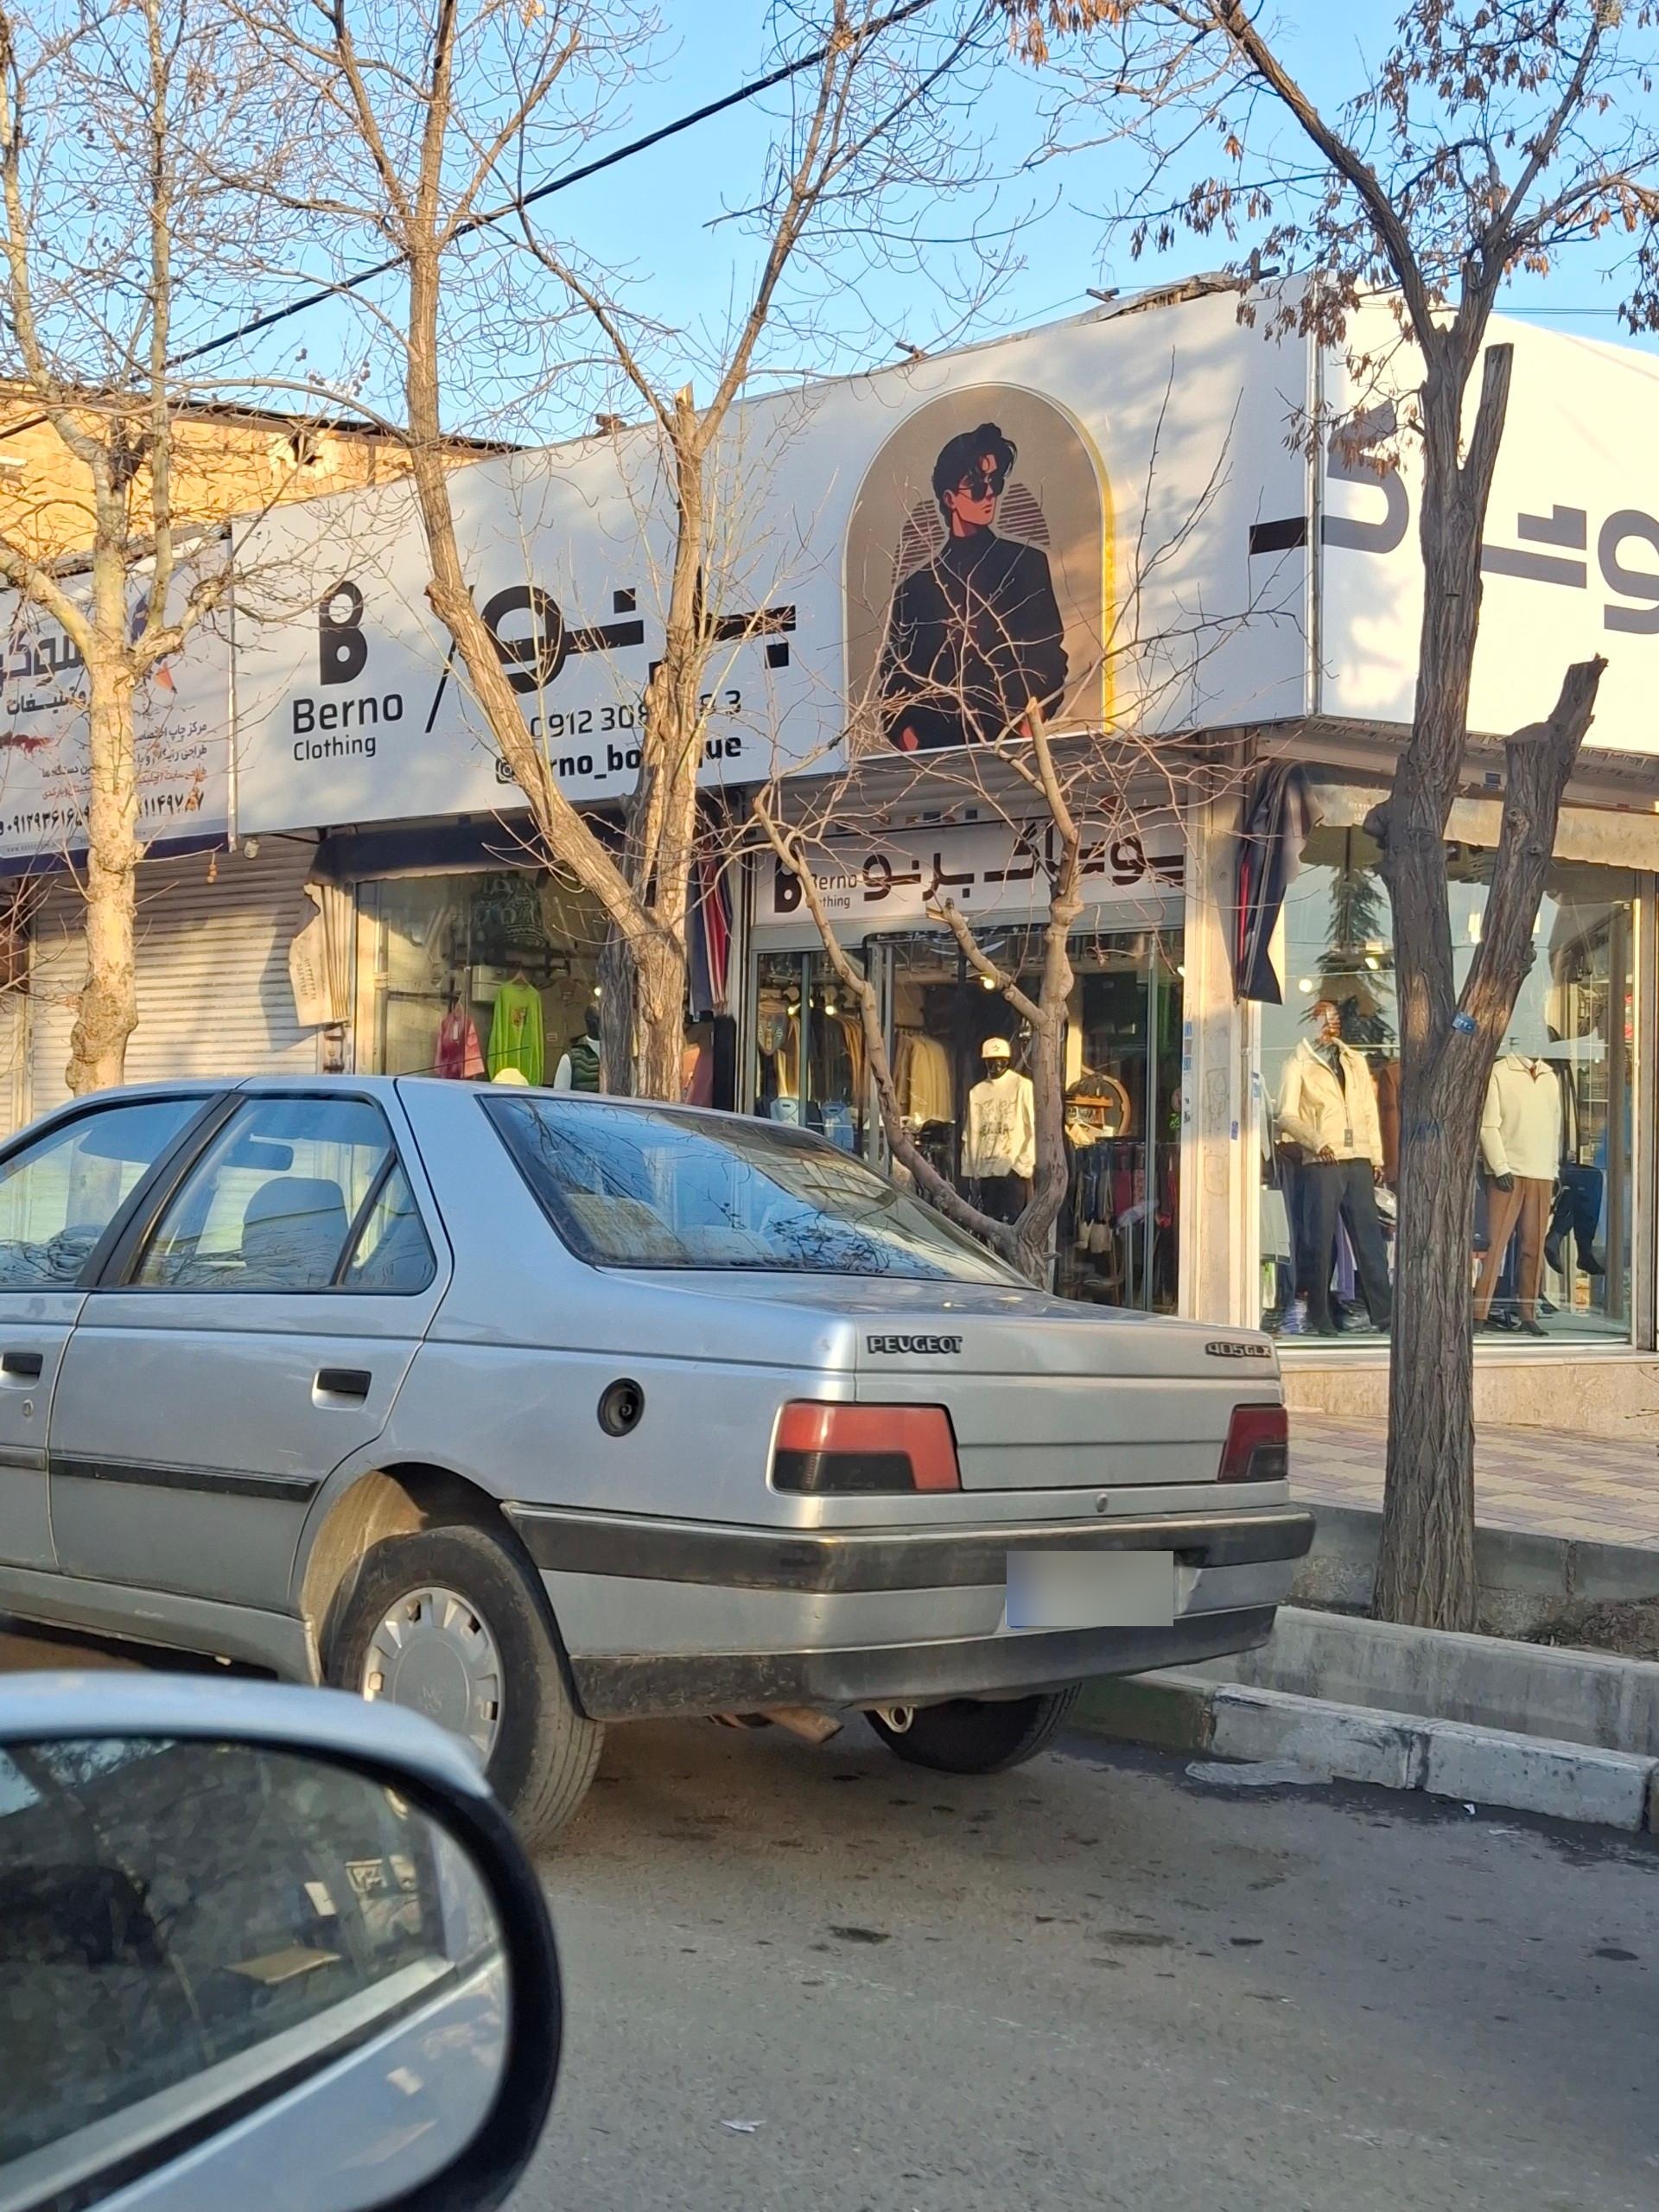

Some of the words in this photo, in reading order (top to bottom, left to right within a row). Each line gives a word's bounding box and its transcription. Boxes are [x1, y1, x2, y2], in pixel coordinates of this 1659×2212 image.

[480, 565, 796, 695] بنو
[293, 693, 404, 734] Berno
[530, 709, 594, 740] 0912
[294, 734, 377, 761] Clothing
[862, 852, 975, 902] برنو
[822, 895, 851, 910] thing
[867, 1335, 963, 1354] PEUGEOT
